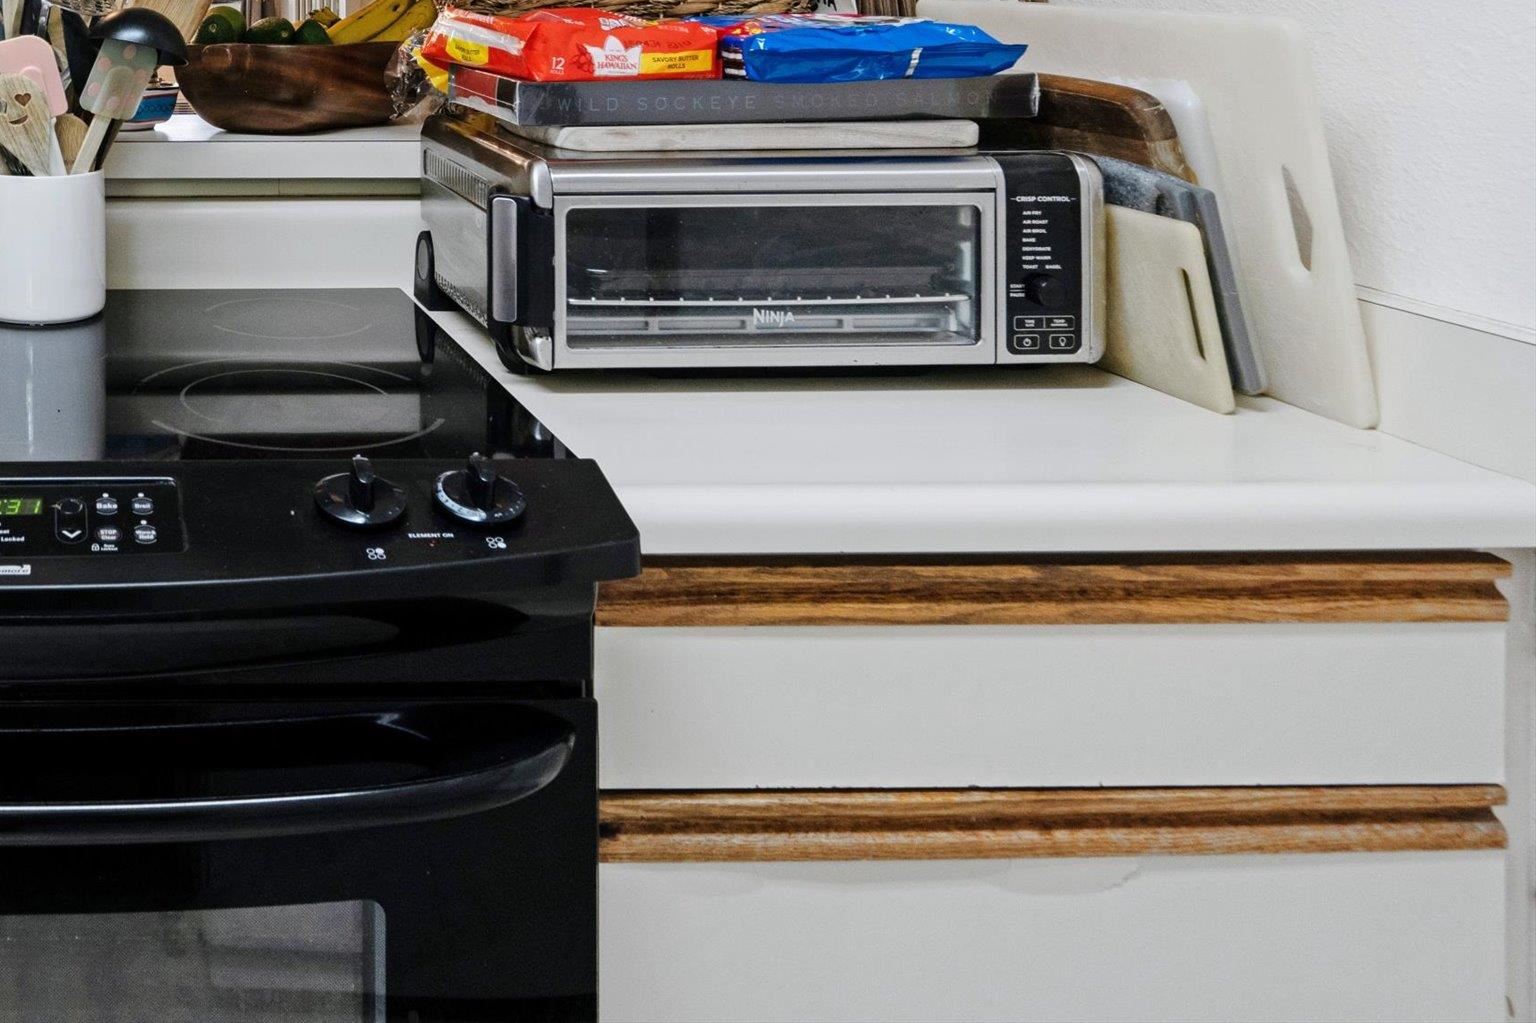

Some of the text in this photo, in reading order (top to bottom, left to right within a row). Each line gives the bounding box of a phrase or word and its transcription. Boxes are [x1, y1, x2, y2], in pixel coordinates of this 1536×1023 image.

[551, 57, 565, 70] 12
[678, 54, 699, 62] BUTTER
[597, 61, 637, 71] HAWAIIAN
[558, 96, 620, 113] WILD
[637, 95, 756, 111] SOCKEYE
